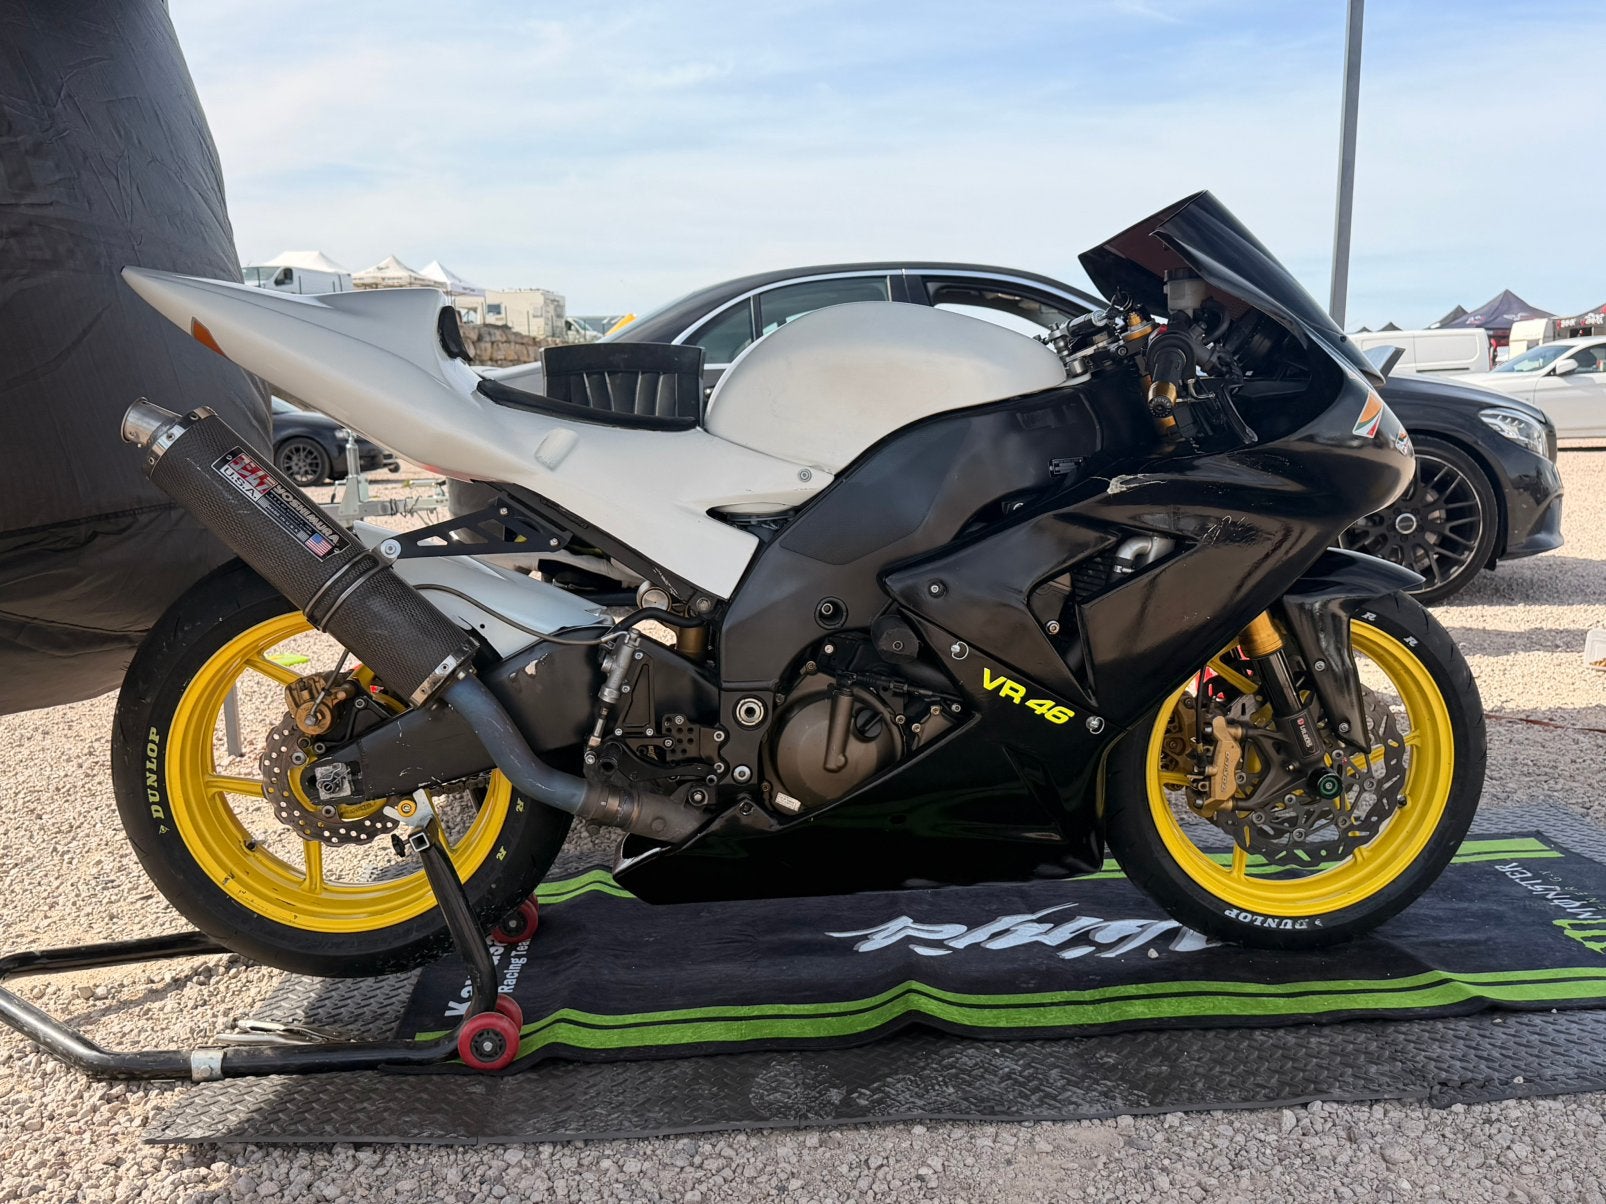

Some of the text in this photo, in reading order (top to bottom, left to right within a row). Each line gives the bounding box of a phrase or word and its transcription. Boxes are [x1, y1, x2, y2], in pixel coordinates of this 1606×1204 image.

[223, 467, 258, 499] U.S.A.
[272, 484, 340, 545] YOSHIMURA
[983, 667, 1075, 724] VR 46
[146, 726, 165, 819] DUNLOP
[1224, 908, 1309, 930] DUNLOP
[1494, 863, 1603, 919] MONSTER
[498, 939, 531, 993] Racing Tea
